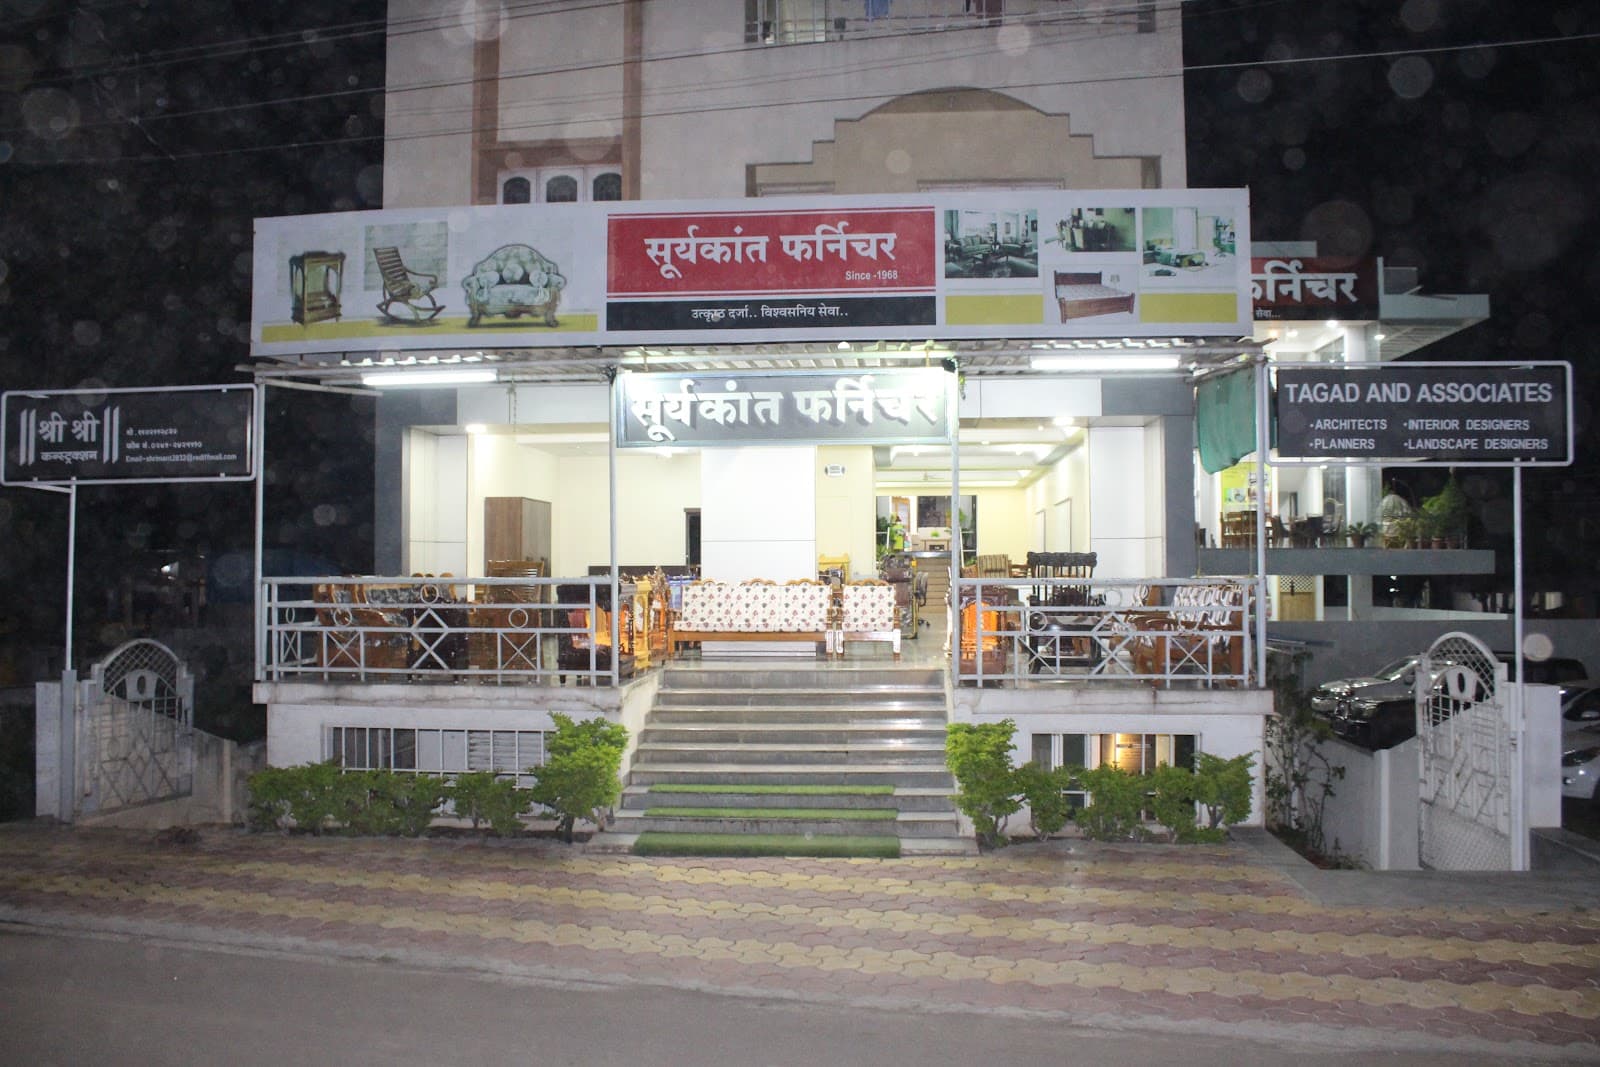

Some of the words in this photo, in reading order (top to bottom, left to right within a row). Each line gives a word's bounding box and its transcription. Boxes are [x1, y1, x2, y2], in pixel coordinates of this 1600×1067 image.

[644, 224, 769, 279] सूर्यकांत
[779, 221, 897, 262] फर्निचर
[845, 270, 871, 281] Since
[1285, 383, 1360, 404] TAGAD
[1366, 382, 1411, 403] AND
[1416, 382, 1553, 403] ASSOCIATES
[631, 378, 782, 442] सूर्यकांत
[792, 374, 939, 424] फर्निचर
[38, 411, 67, 443] श्री
[71, 410, 101, 442] श्री
[1314, 418, 1388, 431] ARCHITECTS
[1407, 418, 1460, 431] INTERIOR
[1466, 419, 1530, 431] DESIGNERS
[1314, 438, 1376, 450] PLANNERS
[1407, 438, 1478, 450] LANDSCAPE
[1484, 438, 1549, 450] DESIGNERS
